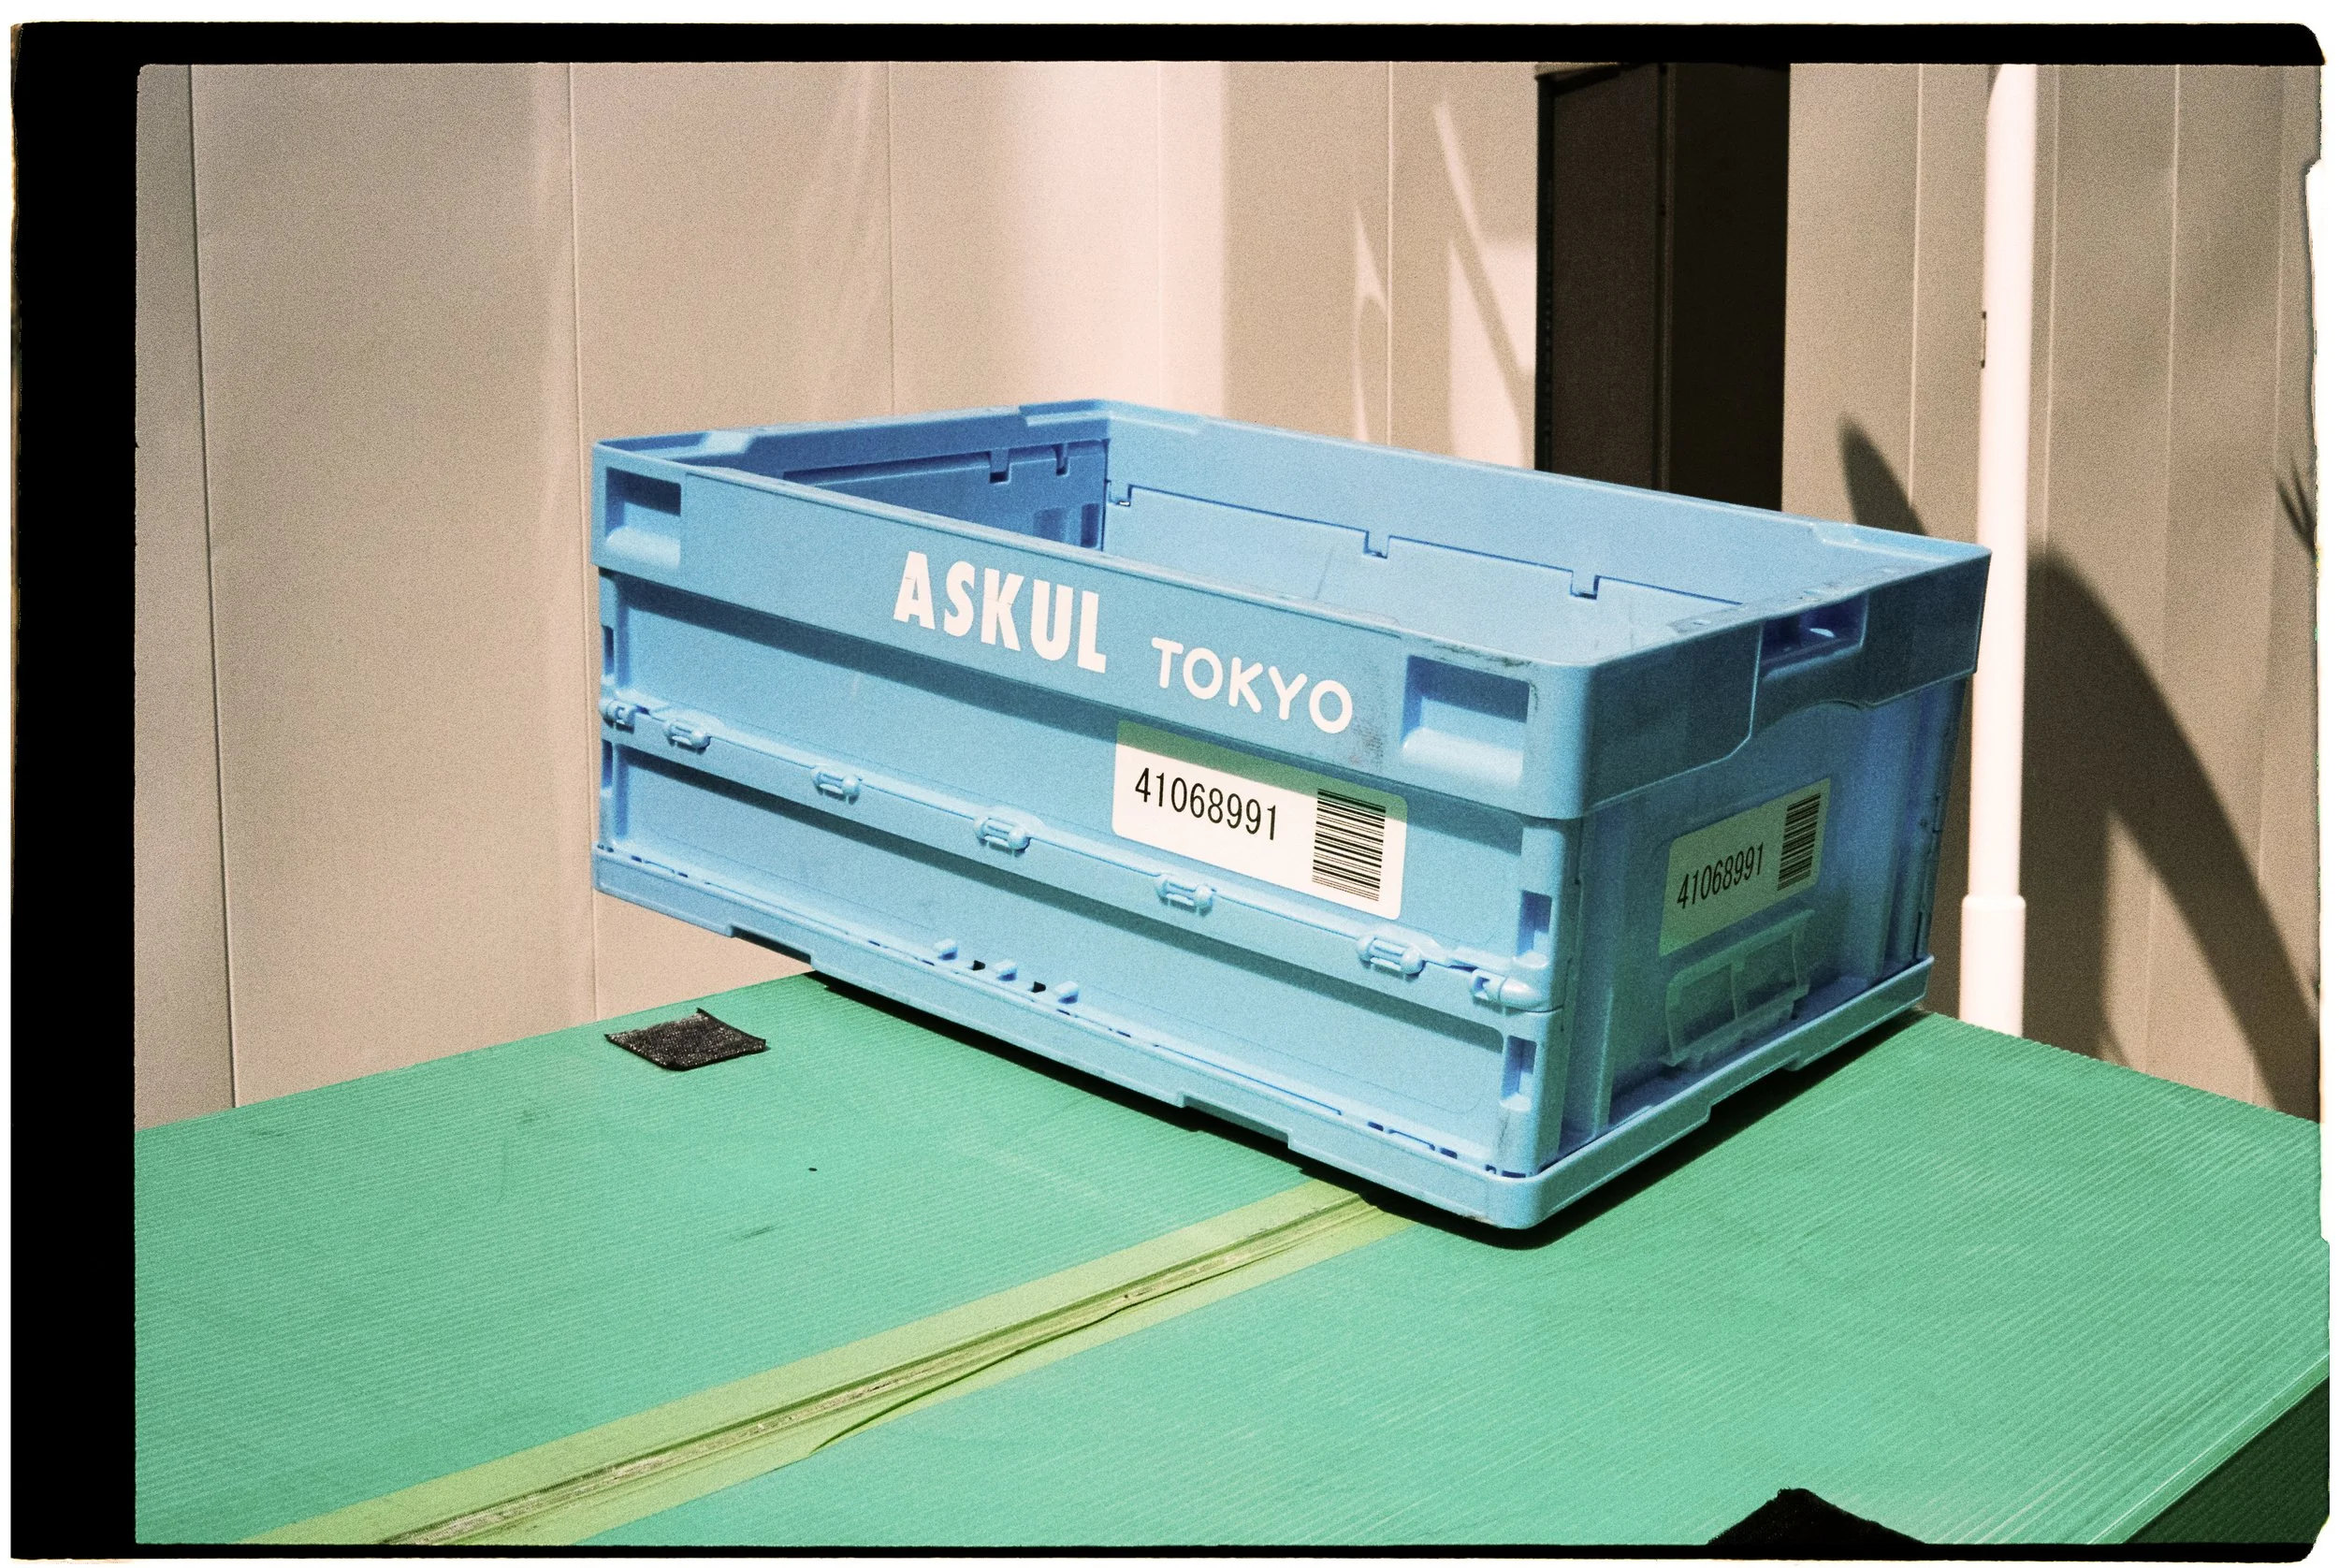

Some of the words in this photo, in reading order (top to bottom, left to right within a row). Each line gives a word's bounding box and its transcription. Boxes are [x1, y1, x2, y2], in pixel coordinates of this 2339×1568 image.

[893, 551, 1107, 674] ASKUL
[1151, 637, 1353, 734] TOKYO
[1134, 767, 1278, 841] 41068991
[1677, 842, 1765, 909] 41068991
